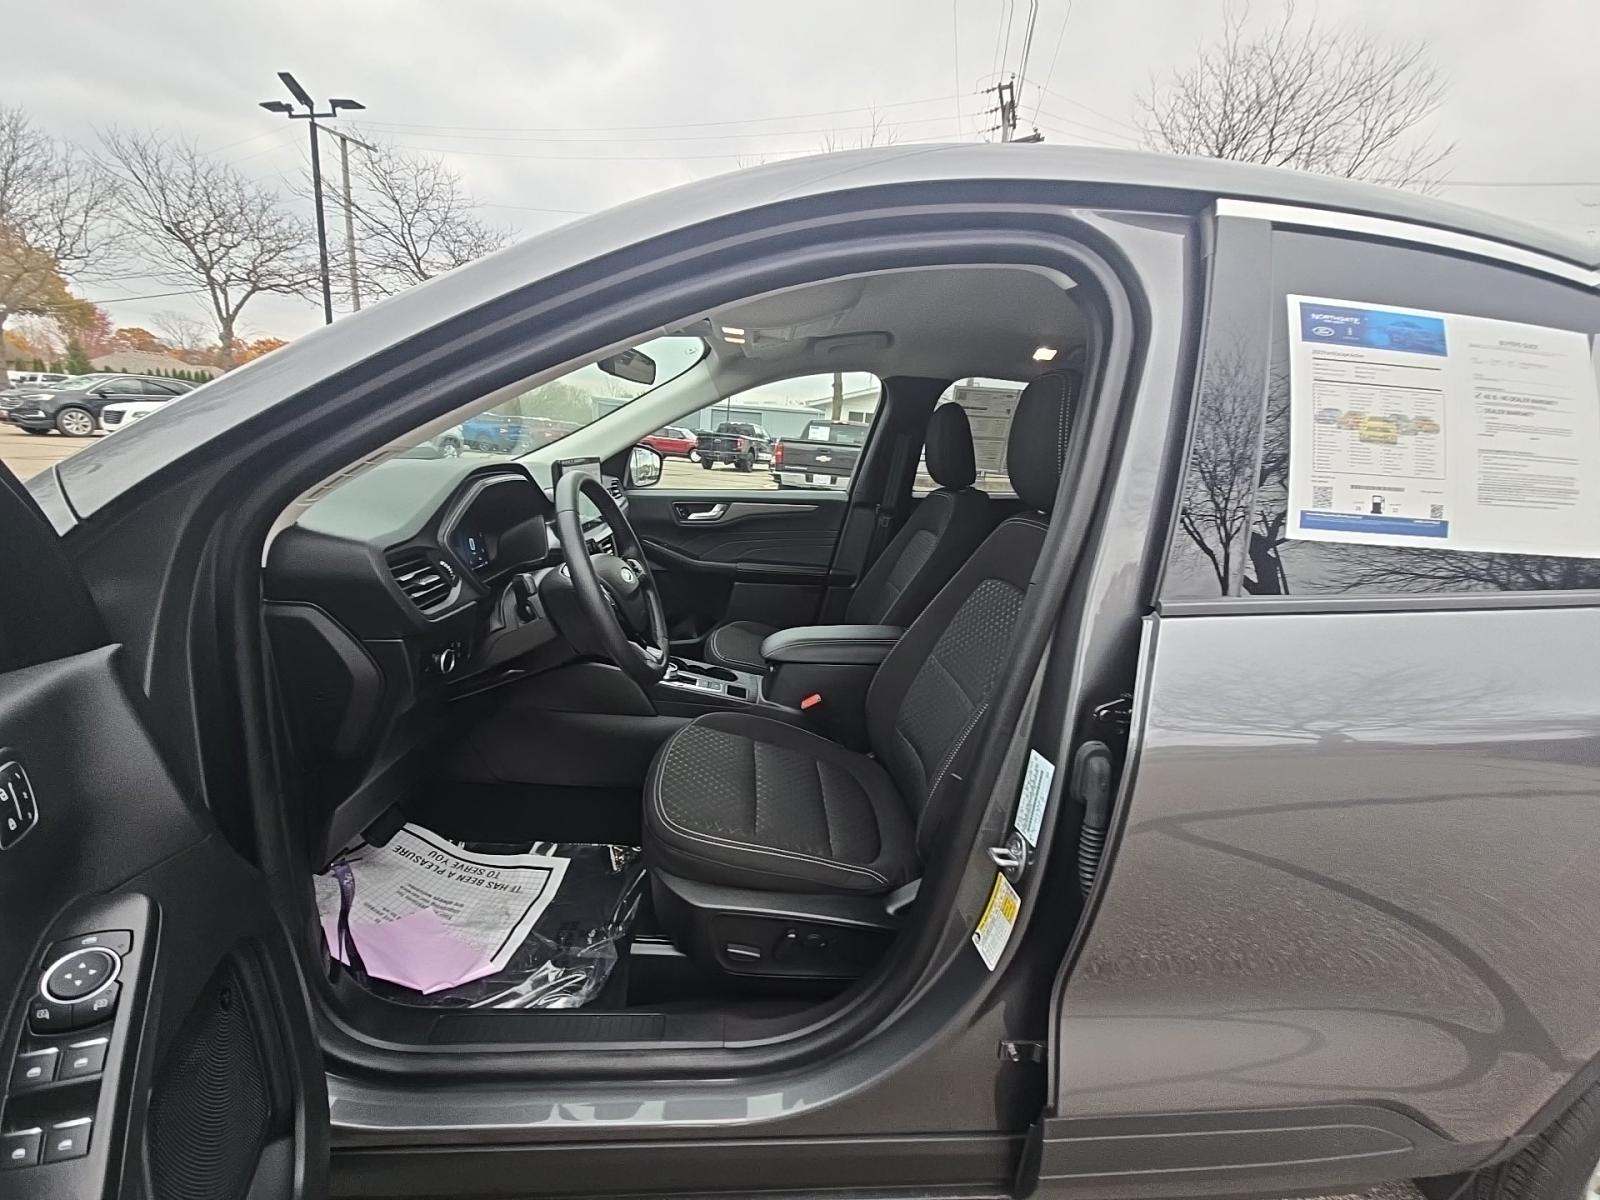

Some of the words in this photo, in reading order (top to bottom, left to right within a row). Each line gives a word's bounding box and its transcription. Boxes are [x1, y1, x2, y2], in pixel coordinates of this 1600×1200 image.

[392, 844, 446, 876] PLEASURE
[427, 850, 450, 866] YOU
[450, 861, 486, 876] SERVE
[447, 871, 456, 879] A
[455, 874, 485, 887] BEEN
[486, 870, 501, 880] TO
[485, 881, 511, 893] HAS
[510, 885, 522, 894] IT
